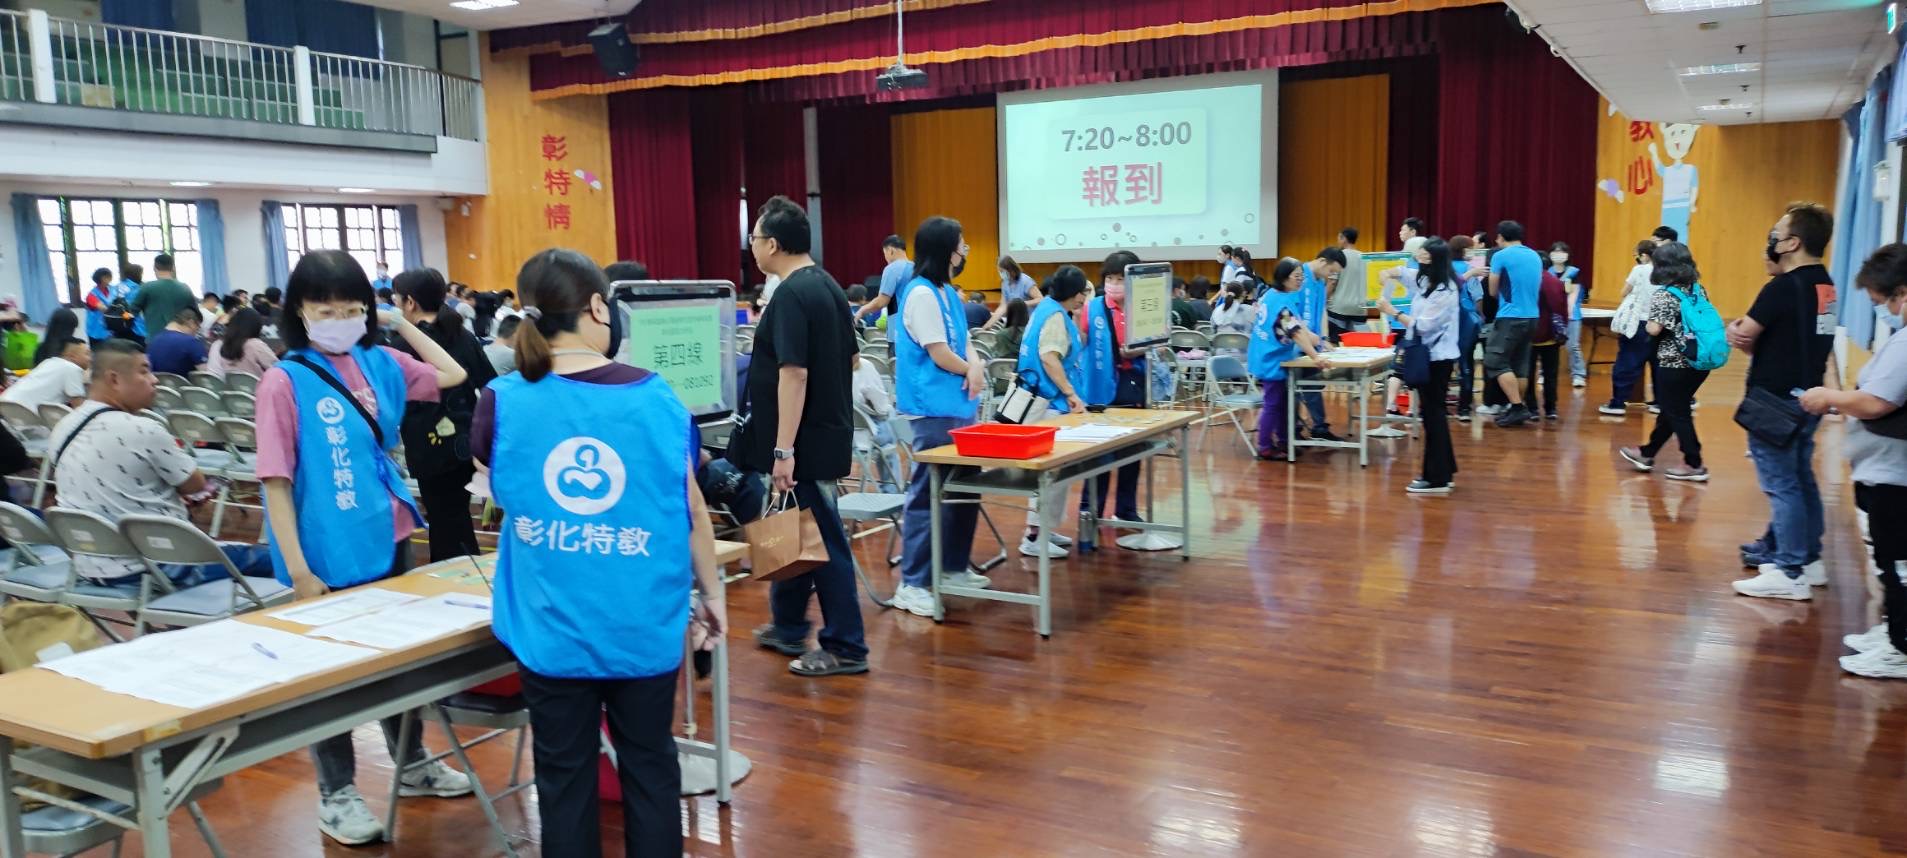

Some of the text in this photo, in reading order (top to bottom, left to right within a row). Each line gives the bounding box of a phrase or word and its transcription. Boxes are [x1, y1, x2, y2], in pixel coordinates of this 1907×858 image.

[1061, 121, 1192, 152] 7:20~8:00
[541, 134, 571, 230] 彰特情
[1082, 161, 1163, 207] 報到
[325, 425, 359, 511] 彰化特教
[514, 515, 652, 557] 彰化特教
